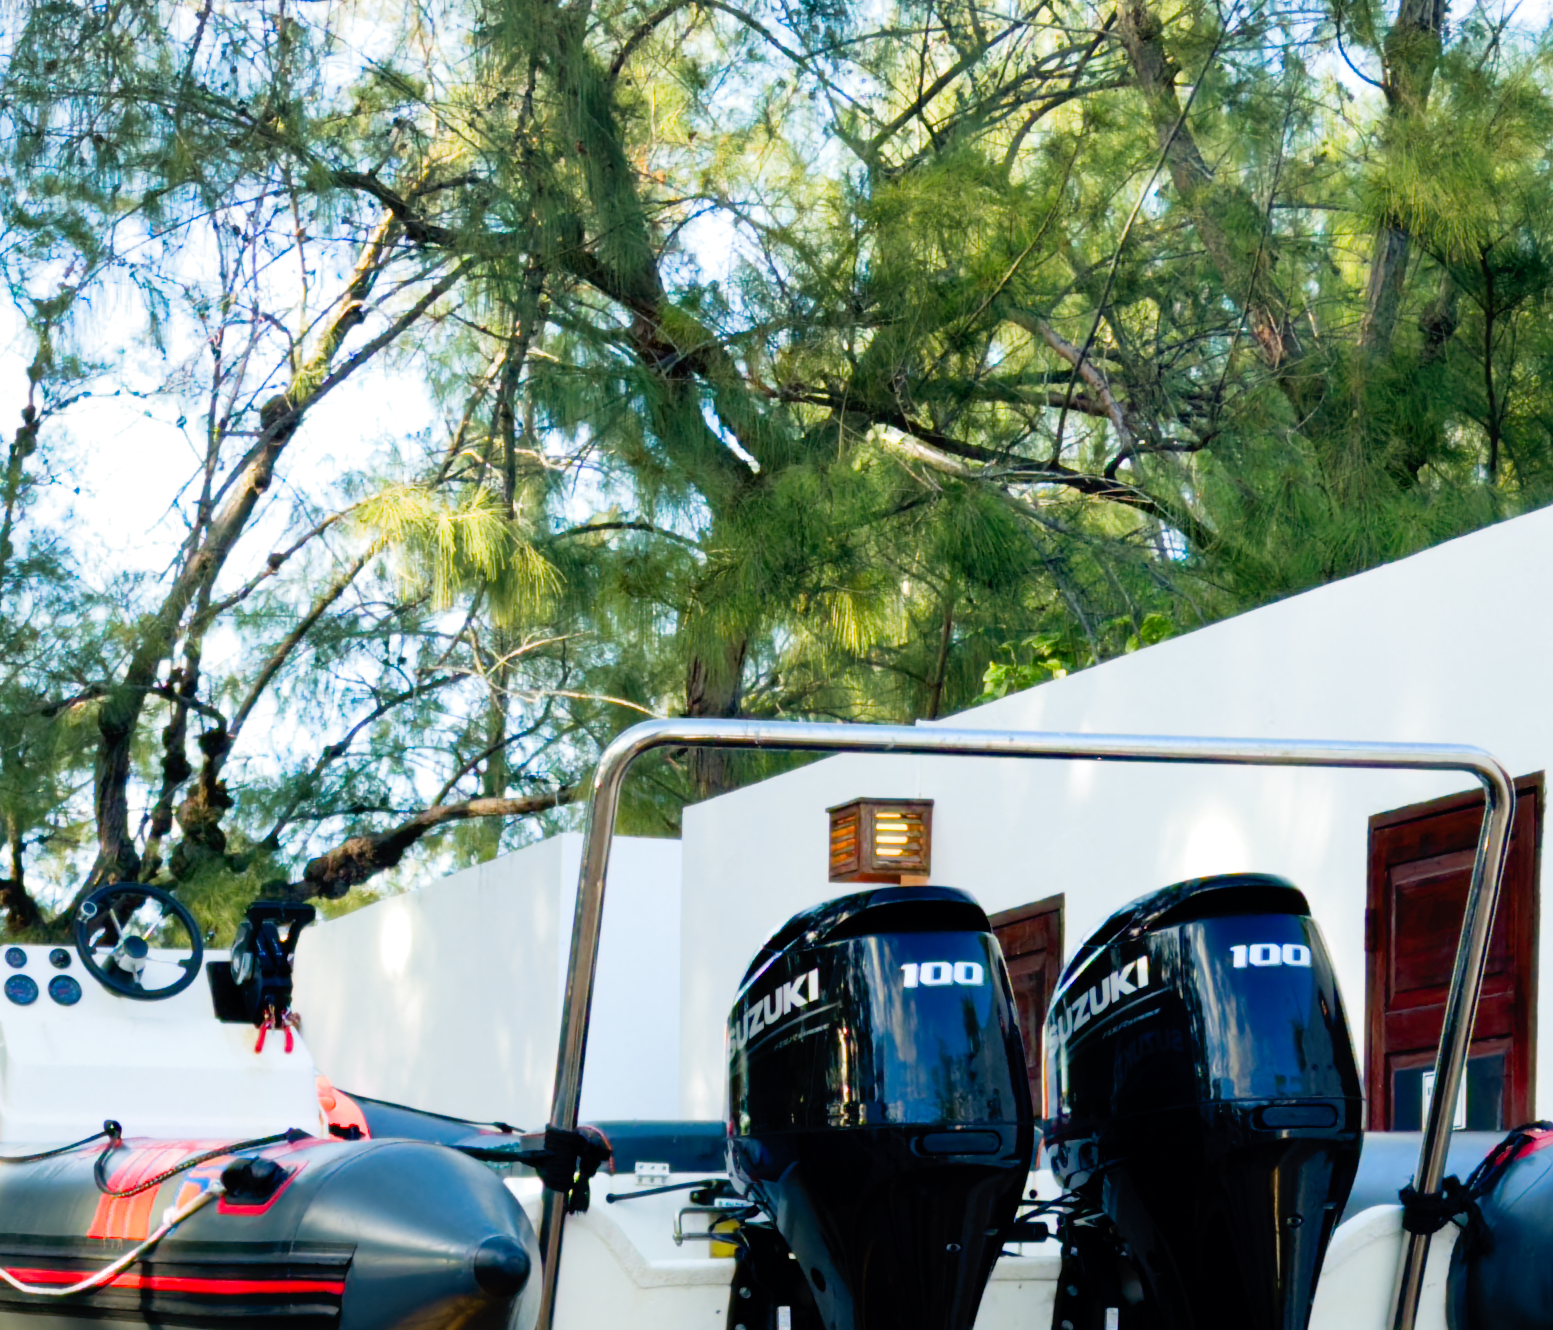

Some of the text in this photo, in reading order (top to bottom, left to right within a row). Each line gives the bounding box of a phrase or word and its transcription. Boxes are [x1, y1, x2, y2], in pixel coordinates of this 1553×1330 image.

[900, 961, 985, 988] 100
[1230, 943, 1312, 969] 100
[728, 967, 819, 1059] SUZUKI
[1047, 954, 1150, 1058] SUZUKI
